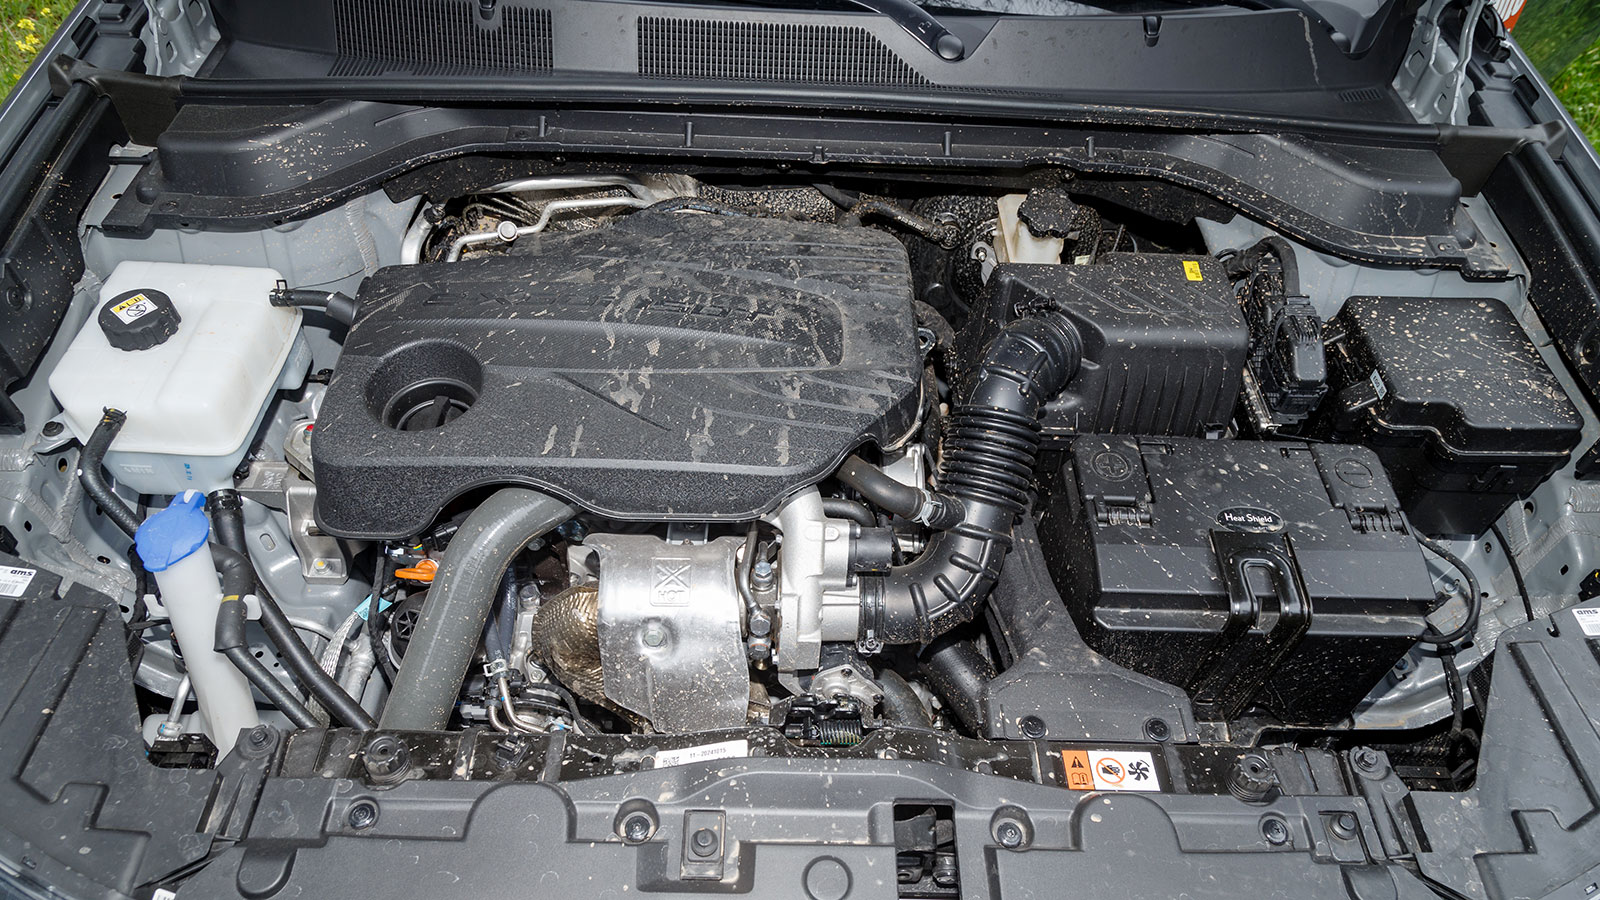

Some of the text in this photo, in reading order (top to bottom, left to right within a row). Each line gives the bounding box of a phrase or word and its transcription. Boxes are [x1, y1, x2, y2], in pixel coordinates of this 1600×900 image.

[1224, 512, 1273, 523] Heat Shield
[10, 569, 34, 577] ams
[657, 590, 686, 602] HOT
